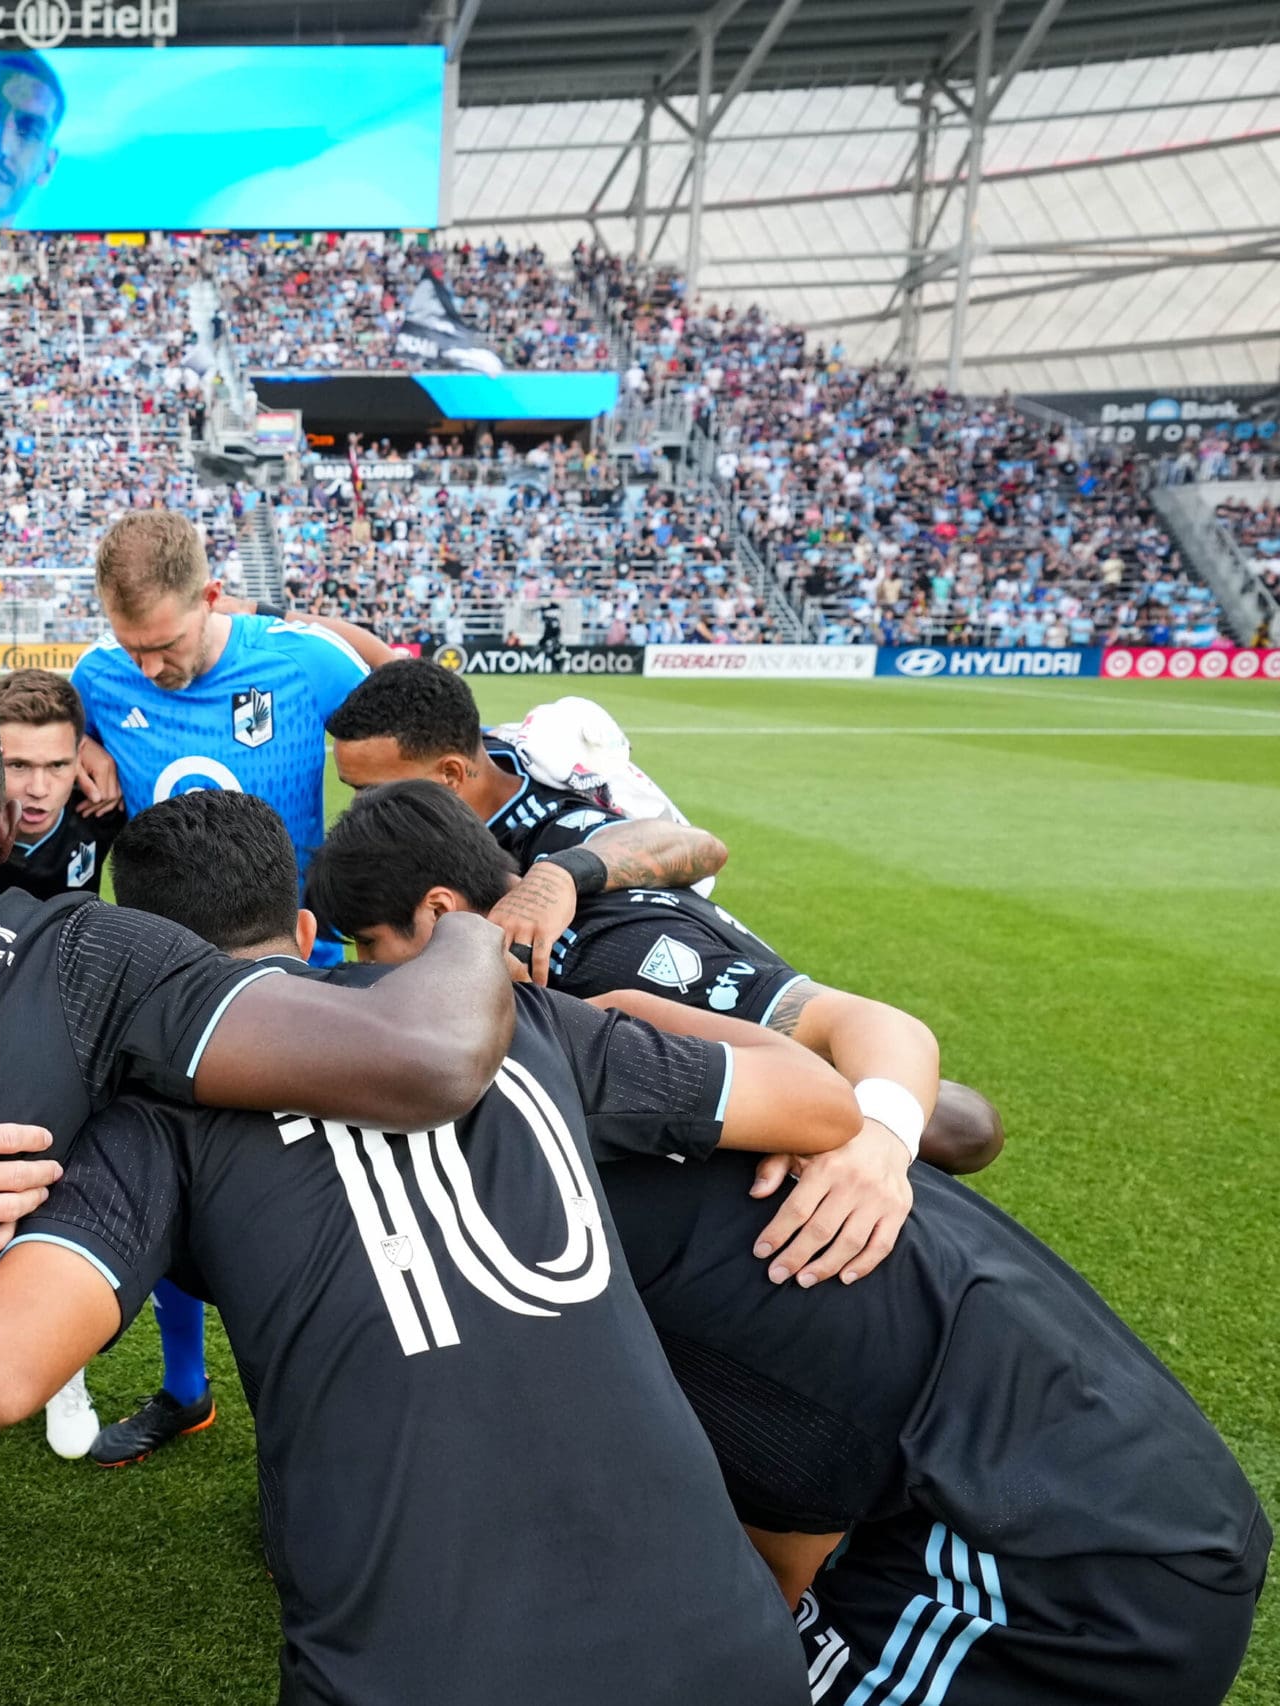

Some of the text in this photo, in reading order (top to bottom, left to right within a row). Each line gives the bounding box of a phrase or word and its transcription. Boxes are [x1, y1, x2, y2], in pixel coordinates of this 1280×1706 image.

[80, 0, 178, 38] Field
[1100, 401, 1241, 423] Bell Bank
[651, 653, 851, 670] FEDERATED INSURANCE
[949, 652, 1082, 675] HYUNDAI
[646, 952, 666, 975] MLS
[272, 1055, 612, 1356] 10
